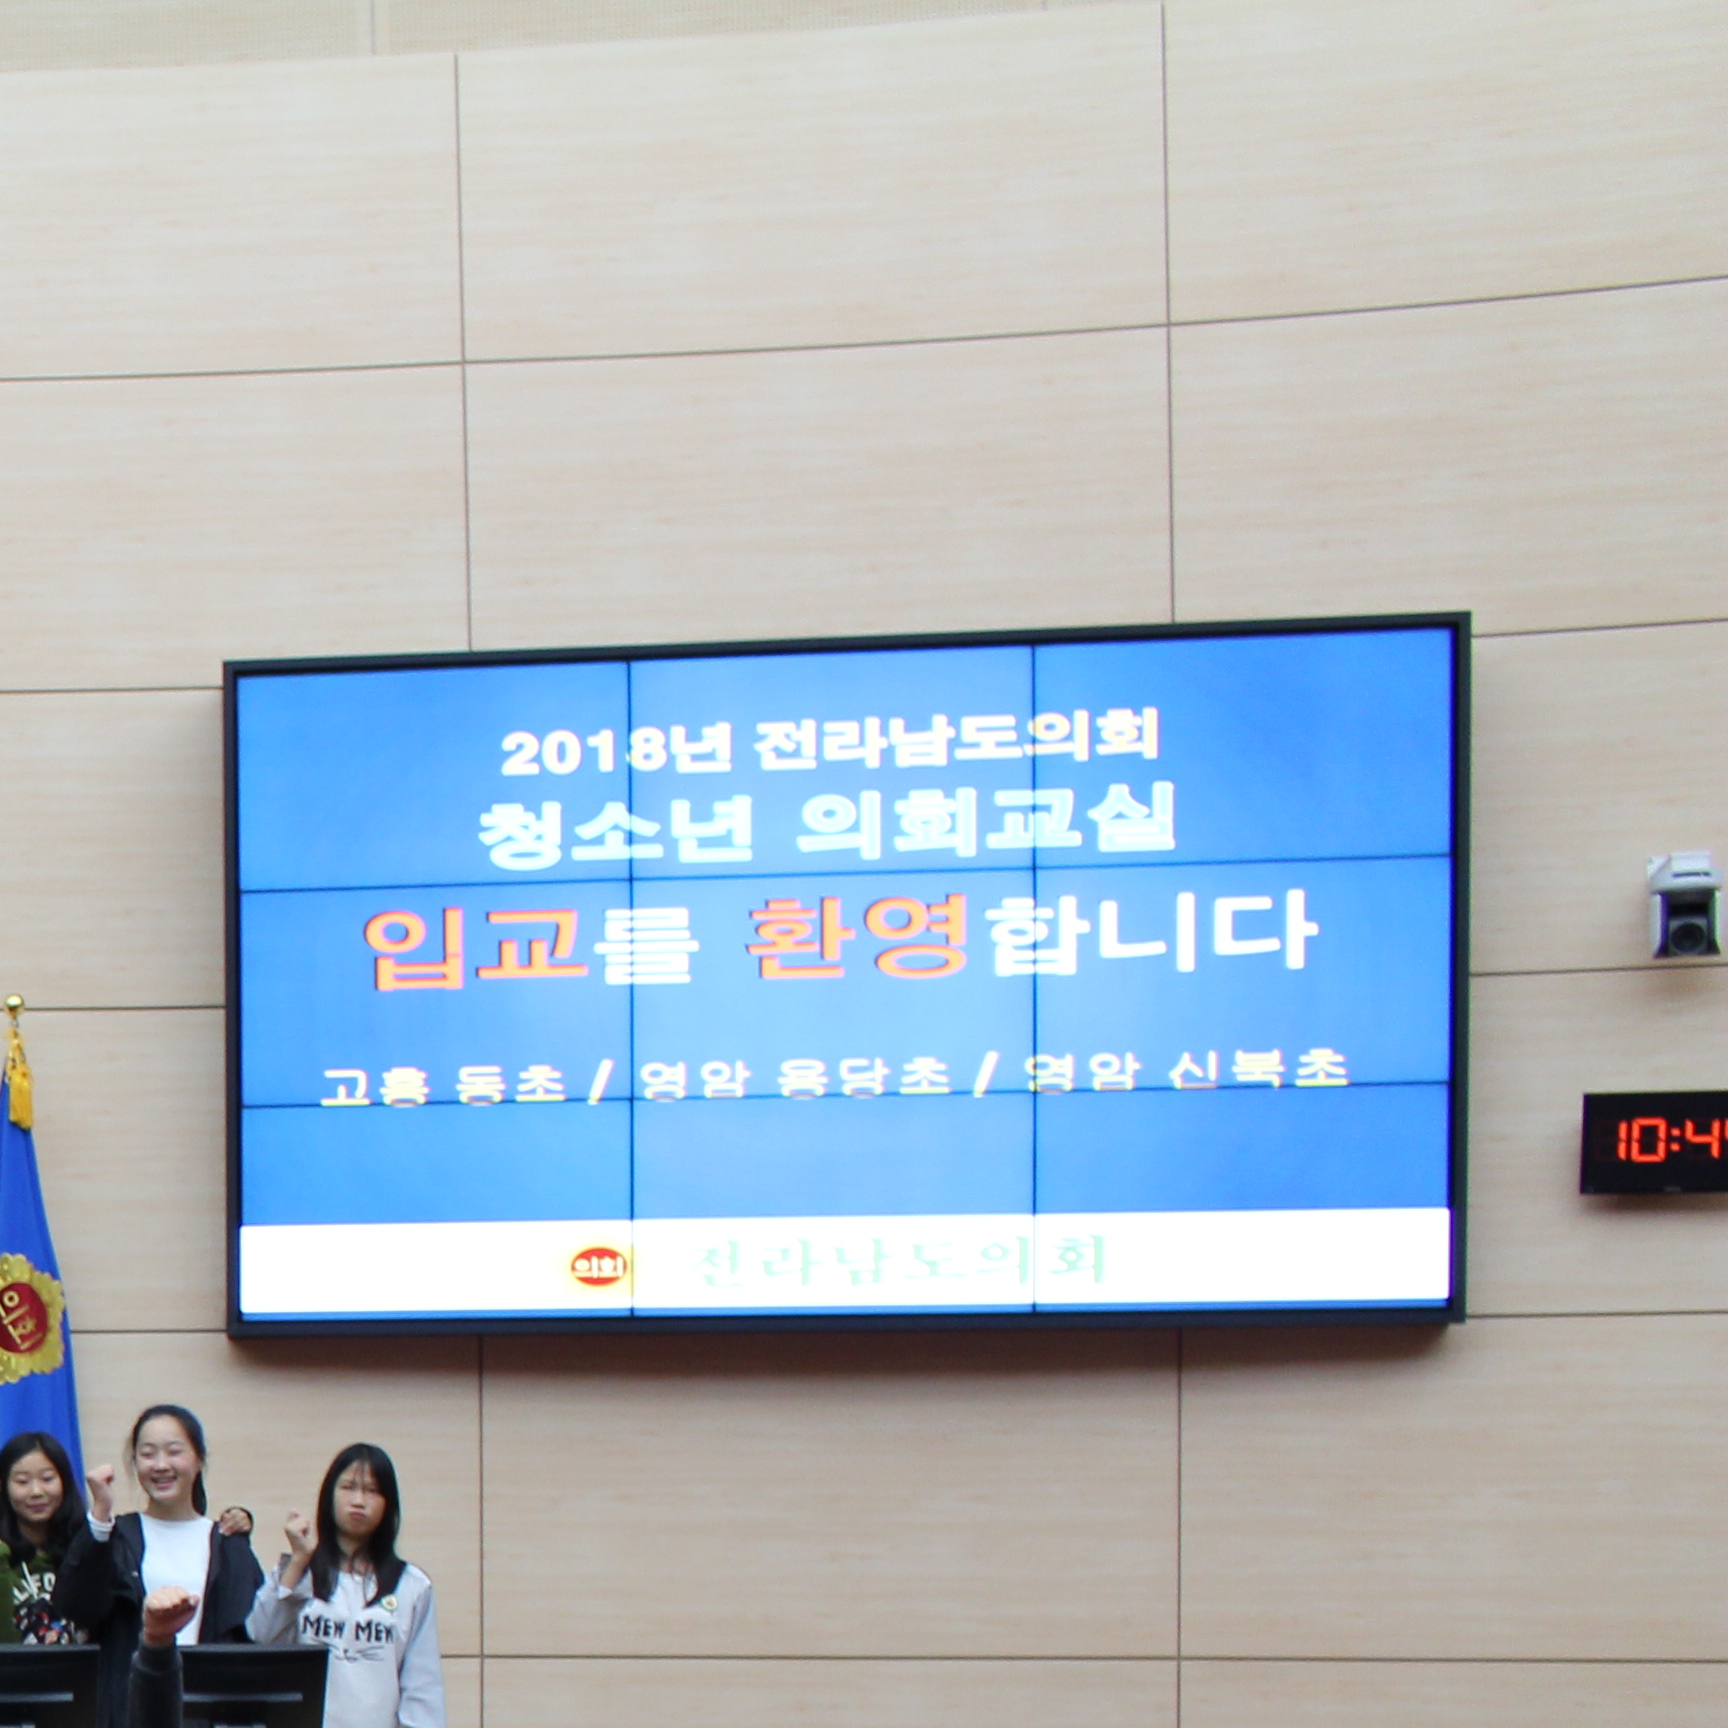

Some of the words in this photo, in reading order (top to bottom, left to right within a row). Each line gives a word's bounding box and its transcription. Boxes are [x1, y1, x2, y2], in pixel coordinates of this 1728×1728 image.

[501, 721, 733, 775] 2018년
[753, 707, 1160, 772] 전라남도의회
[479, 795, 754, 870] 청소년
[796, 781, 1177, 860] 의회교실
[365, 904, 702, 993] 입교를
[746, 888, 1320, 982] 환영합니다
[455, 1064, 568, 1107] 동초
[640, 1059, 755, 1103] 영암
[1023, 1051, 1144, 1096] 영암
[1169, 1047, 1351, 1091] 신북초
[1617, 1117, 1728, 1163] 10:4
[692, 1234, 1109, 1288] 전라남도의회
[302, 1614, 345, 1638] MEW
